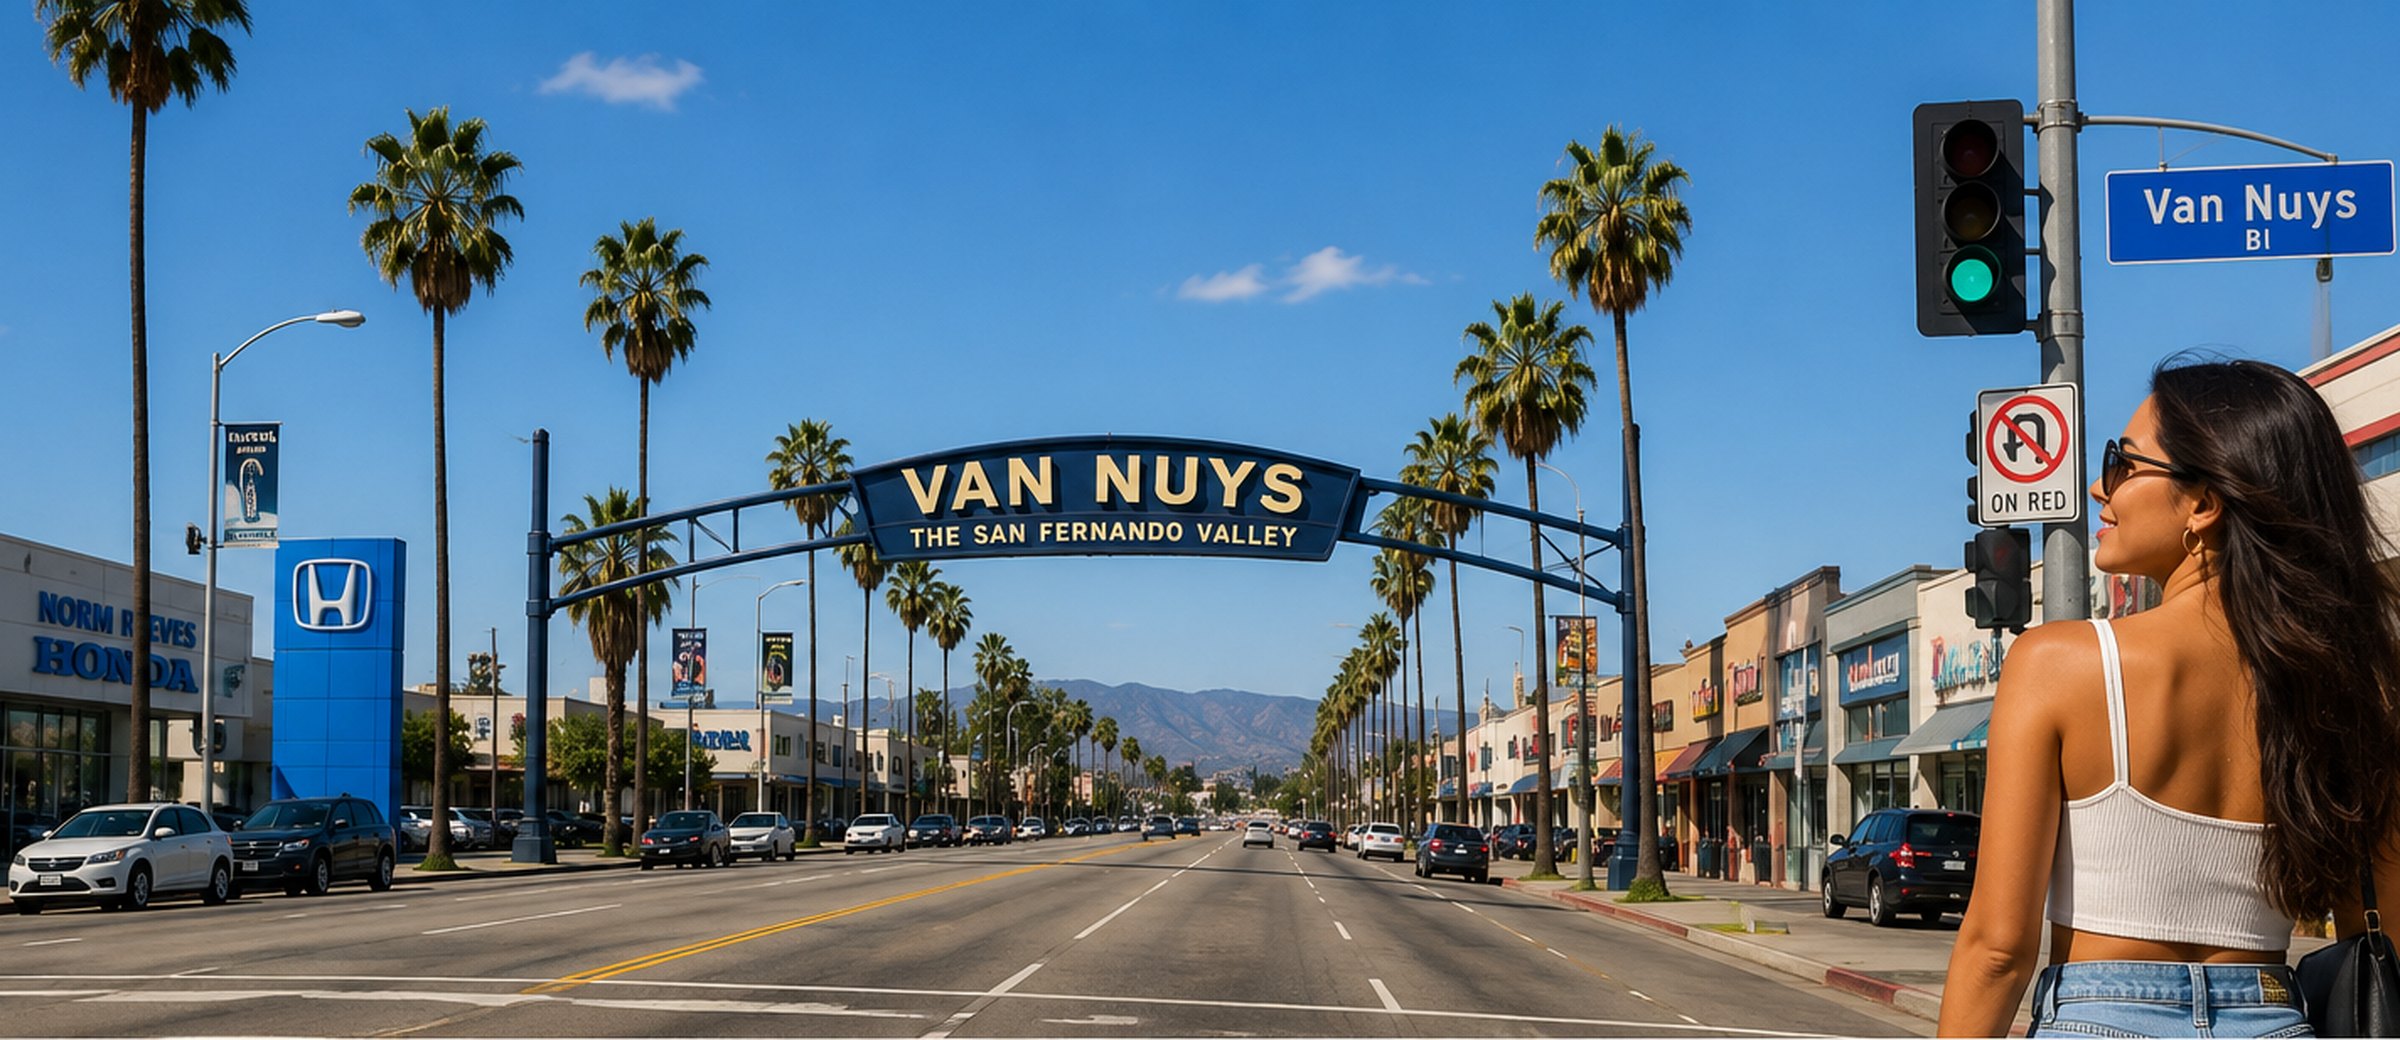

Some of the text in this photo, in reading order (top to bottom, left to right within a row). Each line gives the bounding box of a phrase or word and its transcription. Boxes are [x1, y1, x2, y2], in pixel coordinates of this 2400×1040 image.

[2143, 183, 2357, 230] Van Nuys
[901, 454, 1303, 515] VAN NUYS
[1991, 490, 2067, 514] ON RED
[909, 521, 1298, 548] THE SAN FERNANDO VALLEY
[38, 590, 197, 649] NORM REVES
